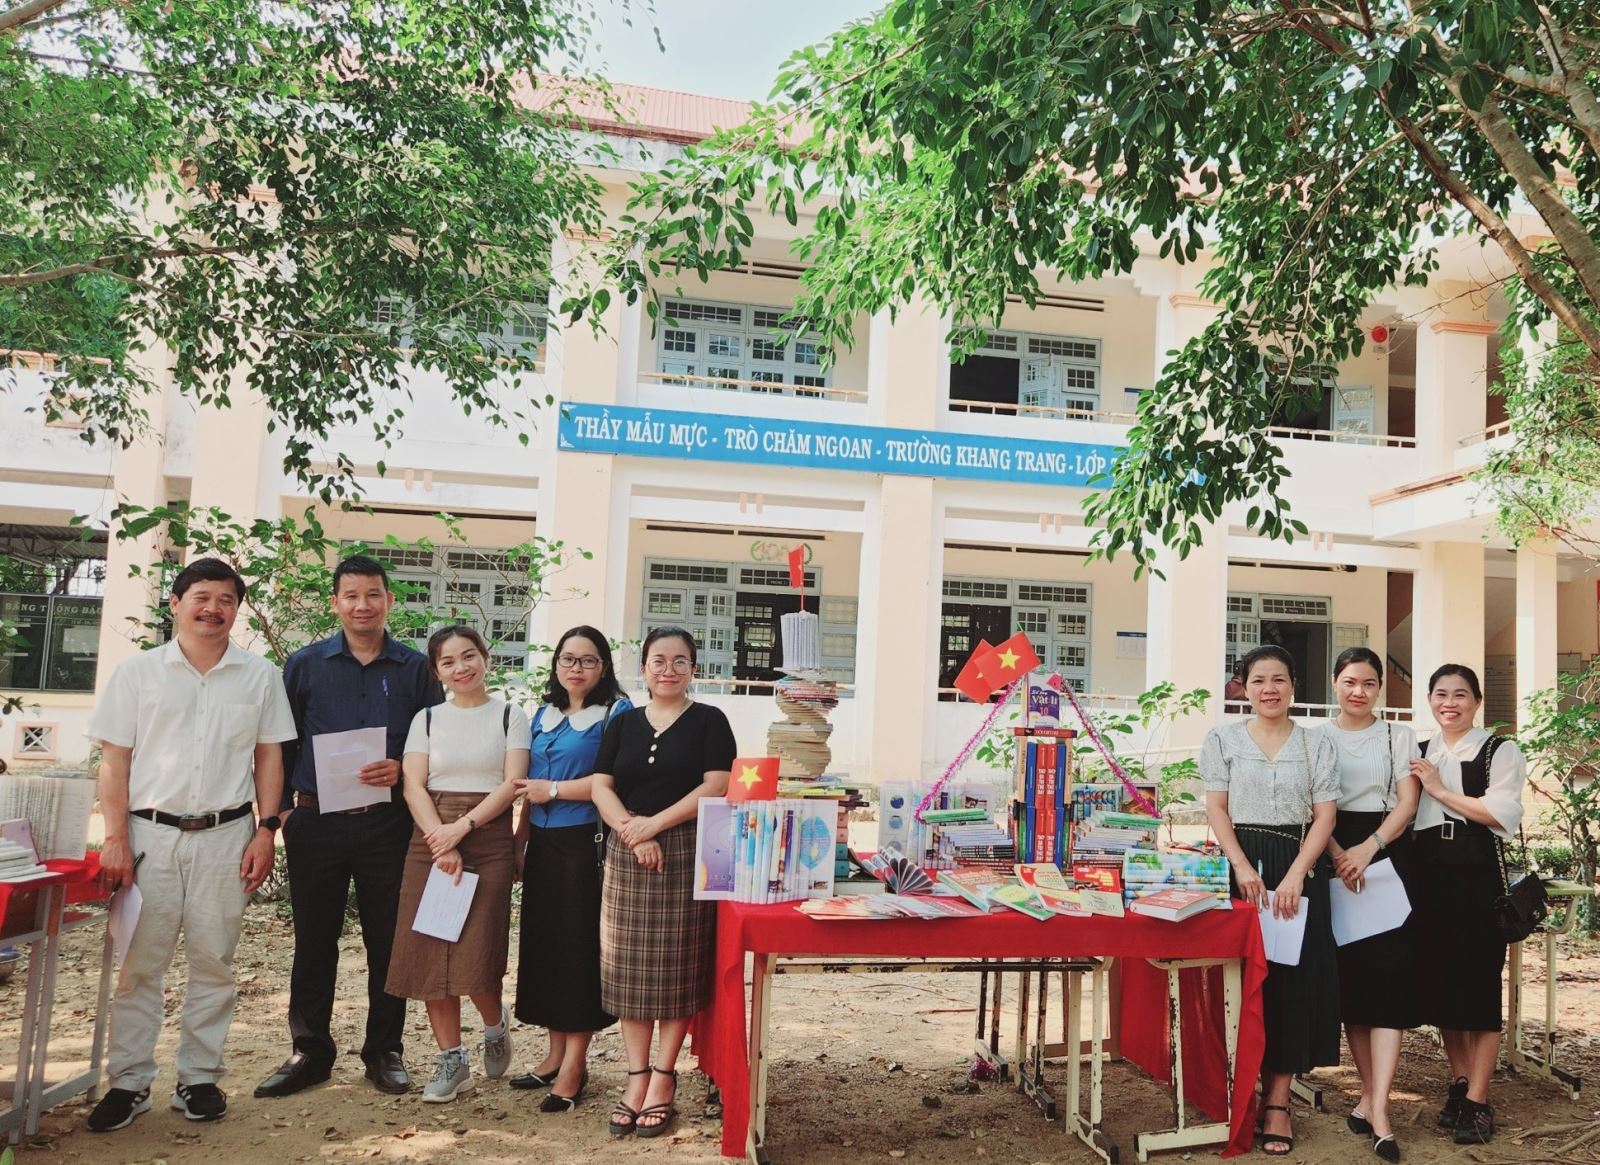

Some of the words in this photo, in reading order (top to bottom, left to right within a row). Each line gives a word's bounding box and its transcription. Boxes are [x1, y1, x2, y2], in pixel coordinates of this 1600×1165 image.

[574, 407, 622, 441] THẦY
[626, 411, 665, 444] MẪU
[669, 422, 708, 452] MỰC
[724, 424, 759, 451] TRÒ
[763, 428, 812, 456] CHĂM
[815, 435, 873, 459] NGOAN
[886, 435, 951, 465] TRƯỜNG
[956, 445, 1011, 470] KHANG
[1015, 451, 1066, 474] TRANG
[1076, 449, 1107, 476] LỚP
[40, 604, 78, 614] TÔNG
